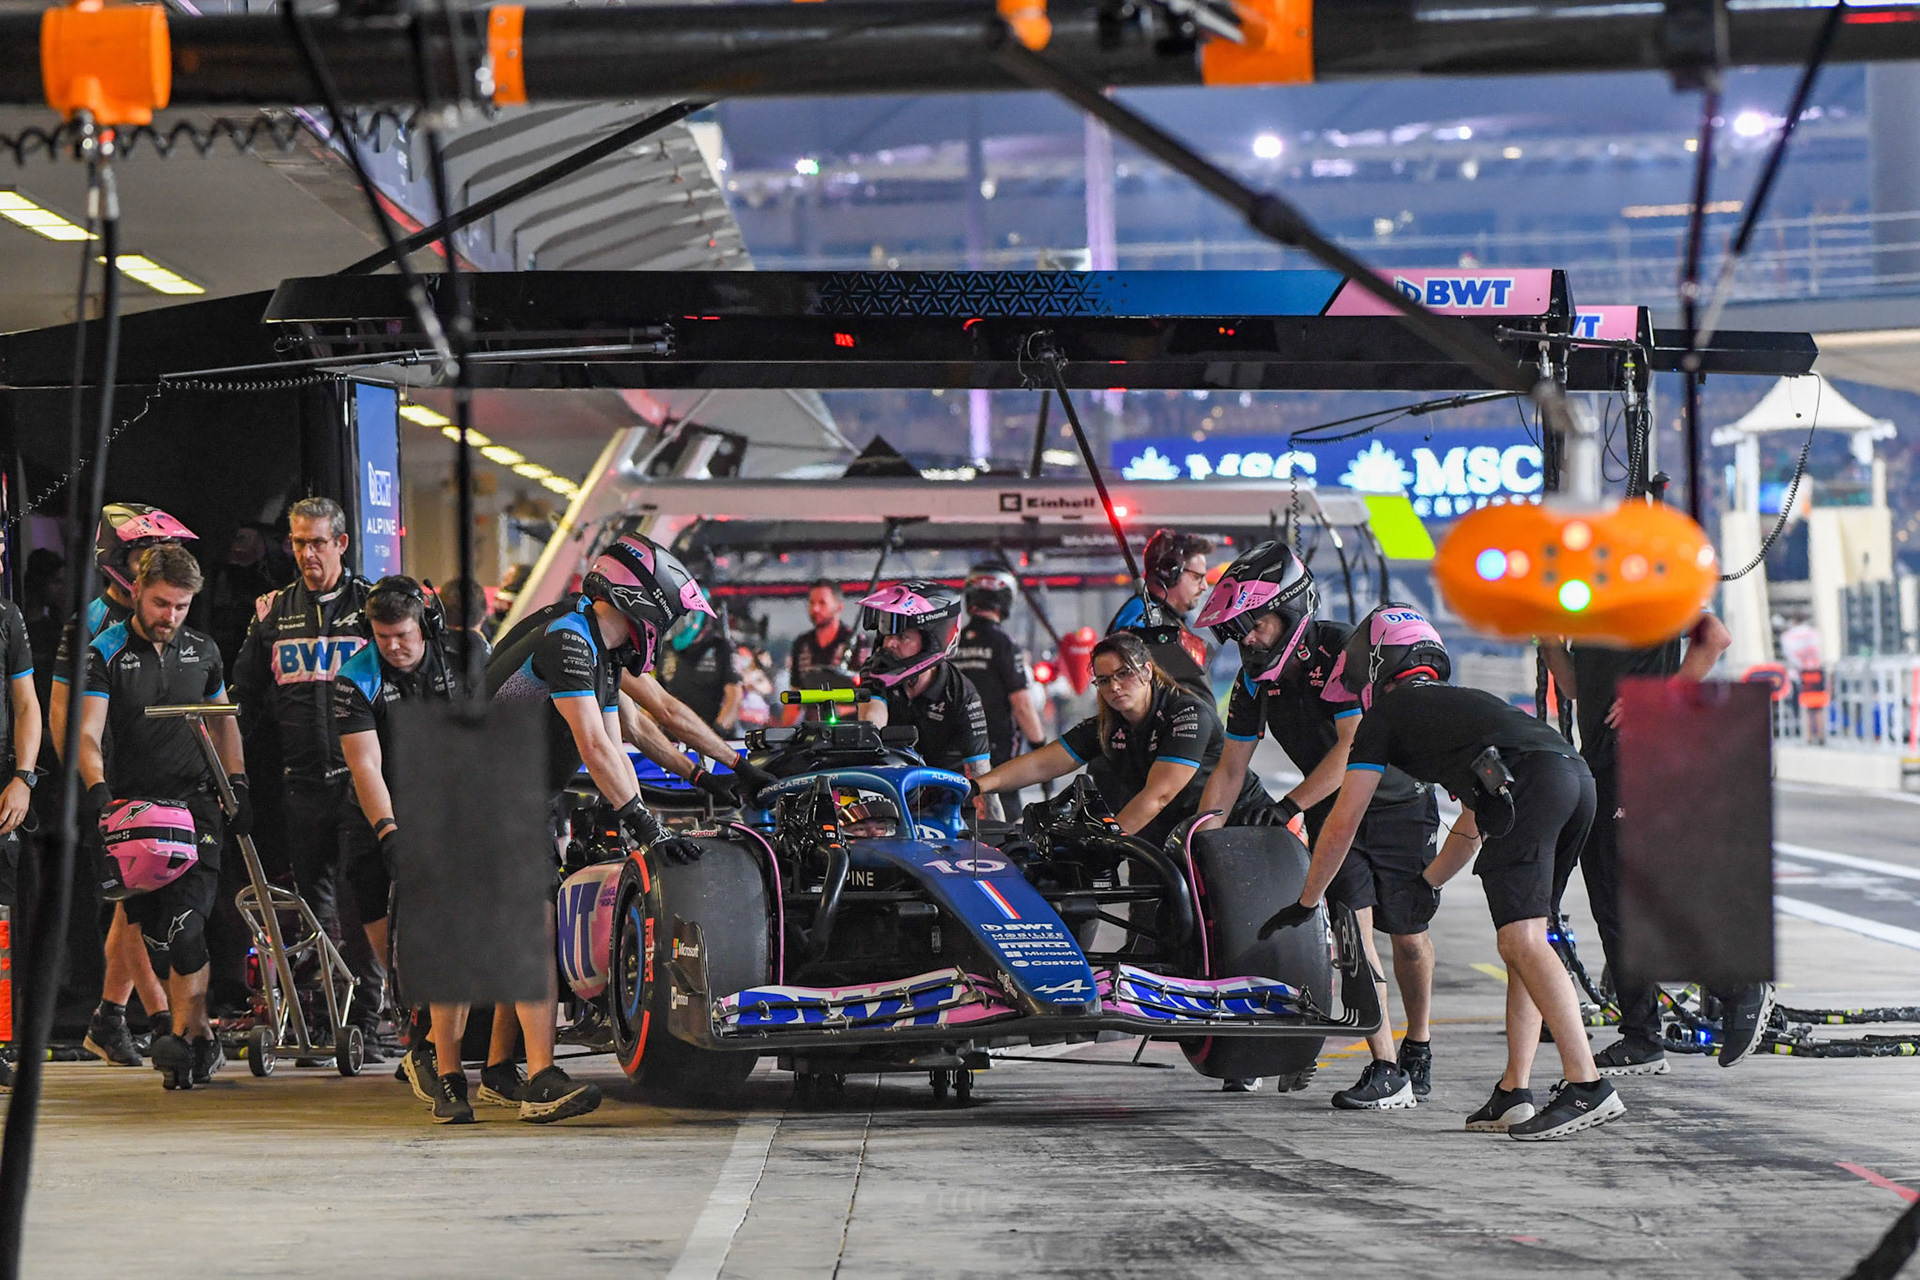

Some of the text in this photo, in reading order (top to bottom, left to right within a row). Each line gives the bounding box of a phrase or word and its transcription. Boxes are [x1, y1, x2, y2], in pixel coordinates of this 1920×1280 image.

[1425, 277, 1514, 307] BWT
[1413, 445, 1543, 495] MSC
[1026, 497, 1096, 509] Einhell
[366, 517, 396, 536] ALPINE
[1280, 577, 1310, 602] shamir
[925, 610, 949, 621] shamir
[279, 640, 357, 675] BWT
[691, 828, 717, 837] Castrol
[922, 859, 1007, 874] 10
[1003, 923, 1054, 931] BWT
[991, 932, 1064, 940] MOBILIZE
[678, 942, 700, 958] Microsoft
[998, 941, 1070, 950] PIRELLI
